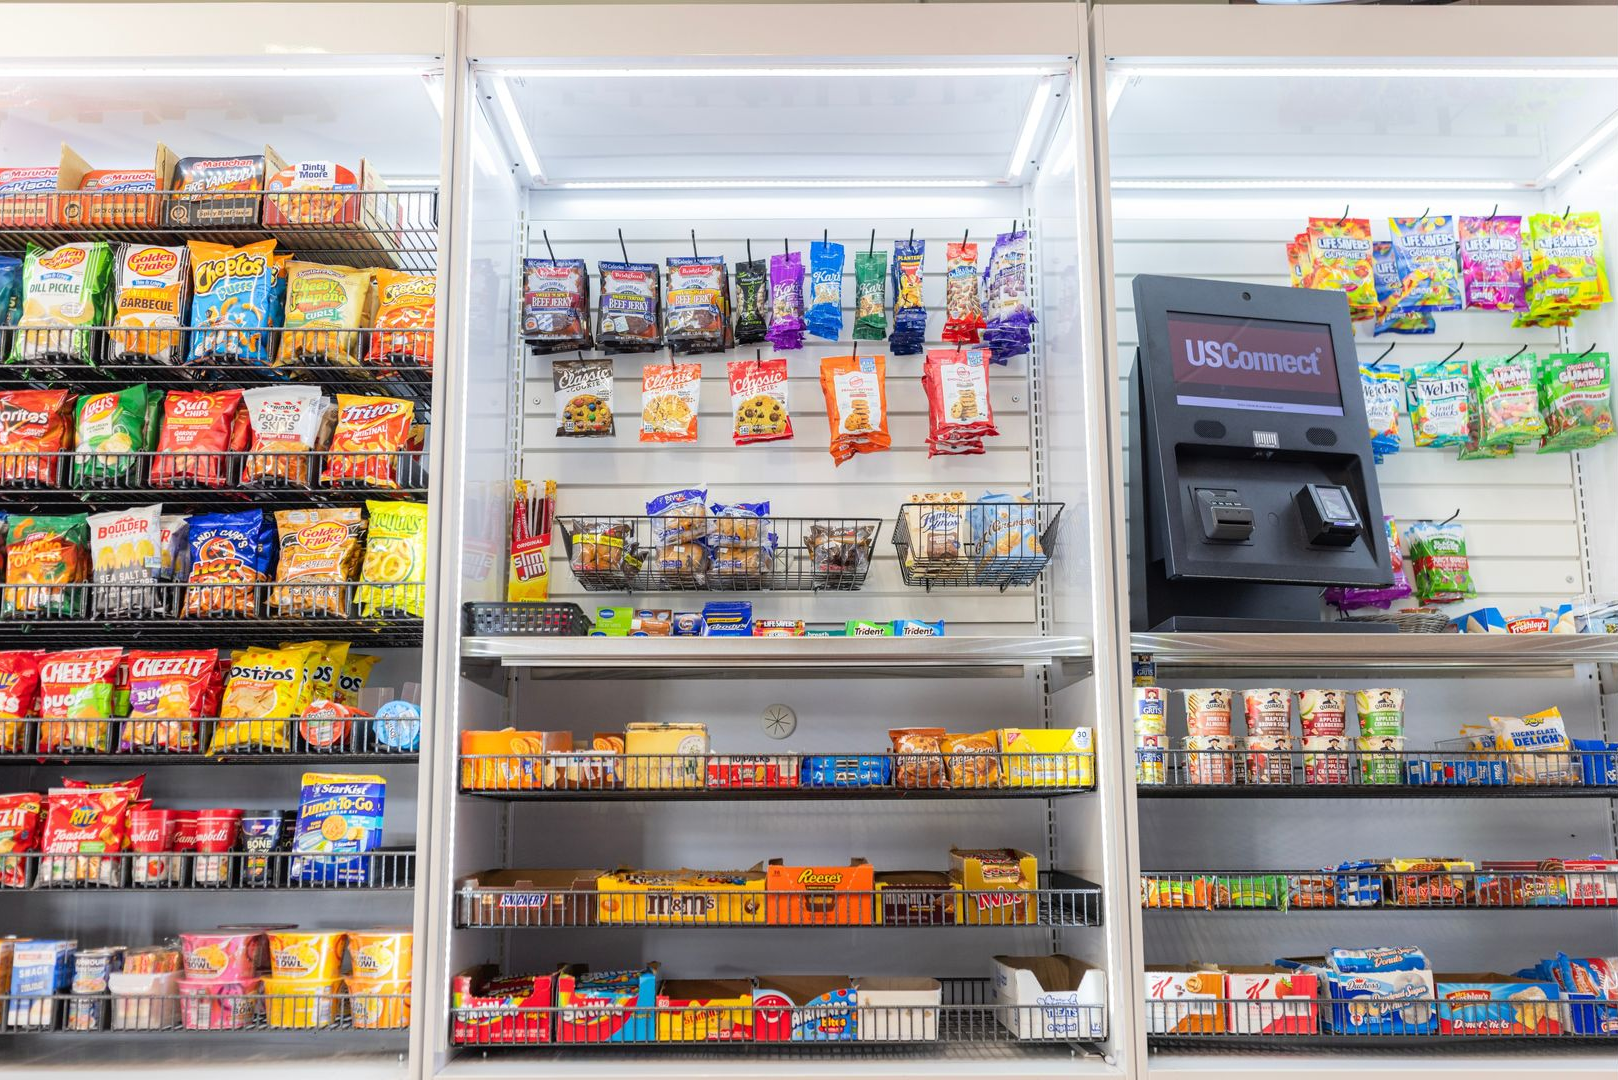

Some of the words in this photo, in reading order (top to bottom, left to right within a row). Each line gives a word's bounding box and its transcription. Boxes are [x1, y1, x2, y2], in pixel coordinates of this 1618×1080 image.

[203, 159, 253, 168] Maruchan
[302, 164, 326, 172] Dinty
[131, 254, 174, 263] Golden
[1324, 250, 1366, 259] GUMMIES
[1409, 248, 1452, 257] GUMMIES
[1472, 253, 1513, 262] GUMMIES
[136, 261, 172, 271] Flake
[197, 253, 265, 294] Cheetos
[813, 271, 841, 283] Kar's
[30, 284, 47, 293] DILL
[48, 282, 80, 294] PICKLE
[293, 279, 339, 293] Cheesy
[121, 299, 174, 311] BARBECUE
[532, 297, 551, 307] BEEF
[551, 297, 573, 307] JERKY
[609, 299, 627, 310] BEEF
[628, 301, 649, 312] JERKY
[675, 294, 691, 305] BEEF
[693, 294, 713, 304] JERKY
[306, 309, 334, 320] CURLS
[1185, 339, 1321, 376] USConnect
[558, 368, 609, 390] Classic
[645, 372, 695, 391] Classic
[1558, 369, 1605, 383] GUMMI
[733, 371, 783, 394] Classic
[1574, 379, 1601, 389] FACTORY
[1421, 381, 1467, 397] Welch's
[84, 396, 115, 419] Lay's
[173, 399, 209, 415] Sun
[1435, 404, 1455, 413] Fruit
[0, 409, 48, 424] oritos
[1430, 409, 1459, 418] Snacks
[98, 520, 148, 539] BOULDER
[301, 527, 347, 540] Golden
[194, 530, 218, 549] ANDY
[305, 537, 342, 547] Flake
[516, 540, 543, 549] ORIGINAL
[194, 559, 241, 576] HOT
[100, 574, 117, 584] SEA
[119, 571, 140, 583] SALT
[854, 627, 885, 636] Trident
[903, 627, 934, 636] Trident
[1511, 622, 1548, 633] Freshley's
[321, 785, 368, 795] StarKist
[69, 807, 100, 825] RITZ
[53, 829, 98, 842] Toasted
[48, 841, 79, 853] CHIPS
[247, 839, 272, 849] BONE
[797, 869, 843, 884] Reese's
[501, 894, 546, 906] SNICKERS
[1374, 955, 1404, 968] Donuts
[1346, 980, 1381, 991] Duchess
[1406, 985, 1427, 997] Sugar
[1047, 1007, 1078, 1017] TREATS
[821, 1018, 846, 1027] bites
